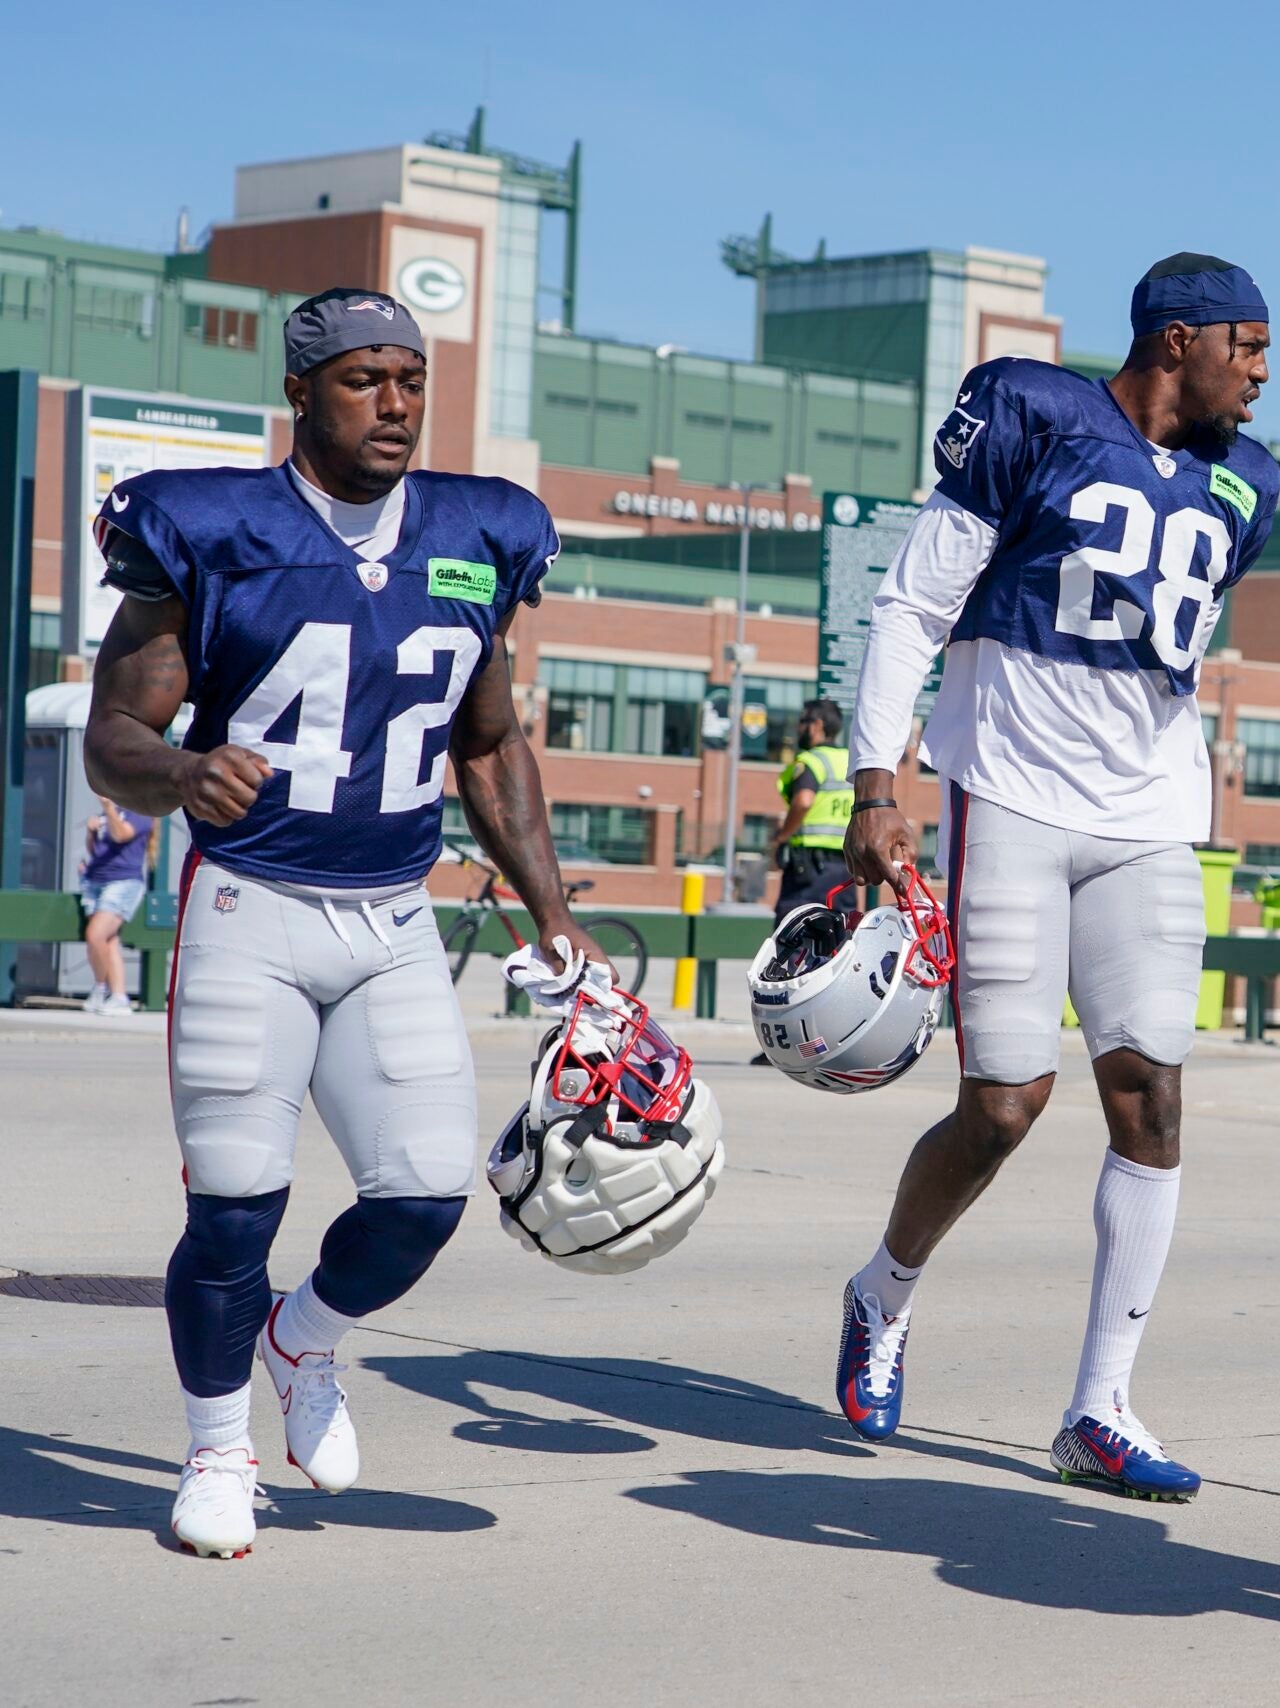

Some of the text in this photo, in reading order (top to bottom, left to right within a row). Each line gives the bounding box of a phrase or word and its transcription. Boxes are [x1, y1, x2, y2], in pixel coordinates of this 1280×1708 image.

[398, 257, 465, 312] G
[188, 414, 219, 429] FIELD
[615, 490, 822, 532] ONEIDA NATION GA
[435, 568, 494, 588] Gillette Labs
[1055, 481, 1232, 671] 28
[228, 622, 482, 813] 42
[831, 799, 851, 817] PO
[760, 1022, 791, 1050] 28
